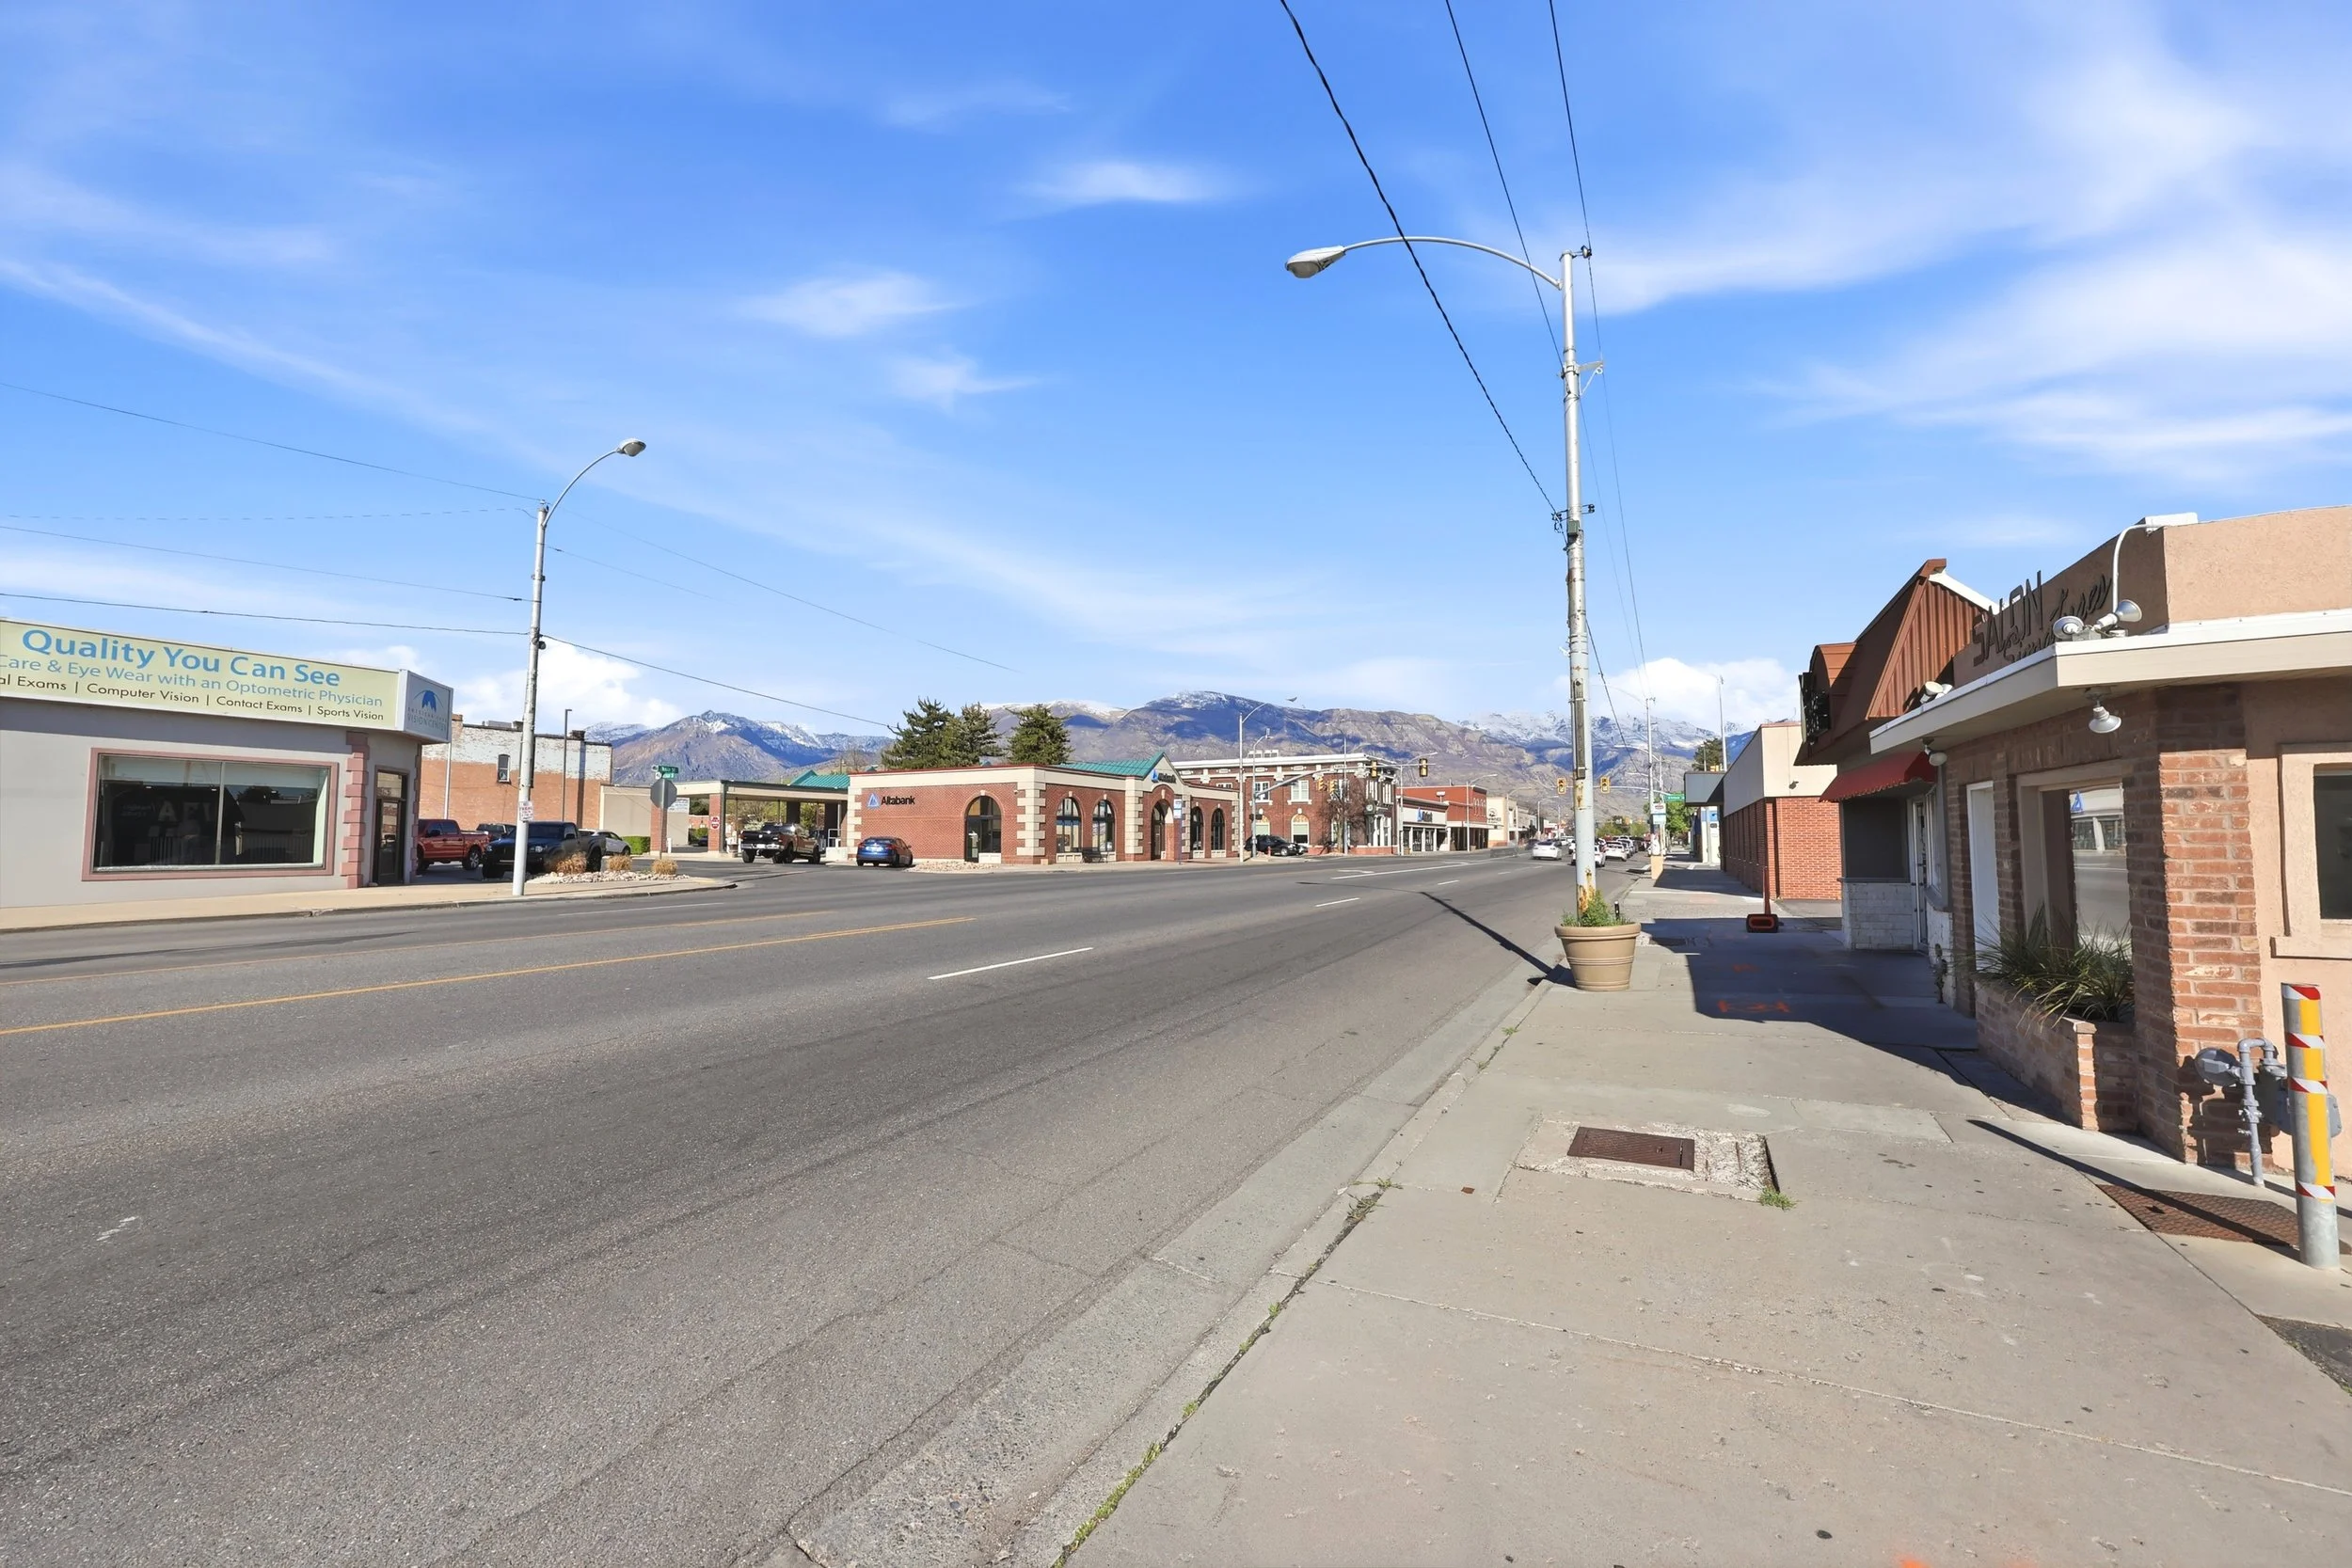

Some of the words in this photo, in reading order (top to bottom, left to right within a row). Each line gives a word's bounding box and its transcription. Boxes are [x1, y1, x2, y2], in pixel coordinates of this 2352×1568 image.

[1973, 570, 2043, 667] SALON
[23, 629, 155, 669] Quality
[164, 646, 220, 673] You
[230, 656, 285, 680] Can
[294, 664, 341, 687] See
[17, 675, 67, 691] Exams
[87, 683, 155, 700] Computer
[160, 690, 199, 704] Vision
[216, 696, 263, 709] Contact
[266, 702, 303, 713] Exams
[317, 706, 350, 719] Sports
[353, 710, 384, 721] Vision
[47, 659, 62, 673] &
[69, 662, 101, 678] Eye
[105, 666, 153, 683] Wear
[157, 674, 196, 688] with
[200, 678, 221, 689] an
[226, 679, 315, 700] Optometric
[319, 689, 383, 707] Physician
[881, 796, 915, 805] Altabank
